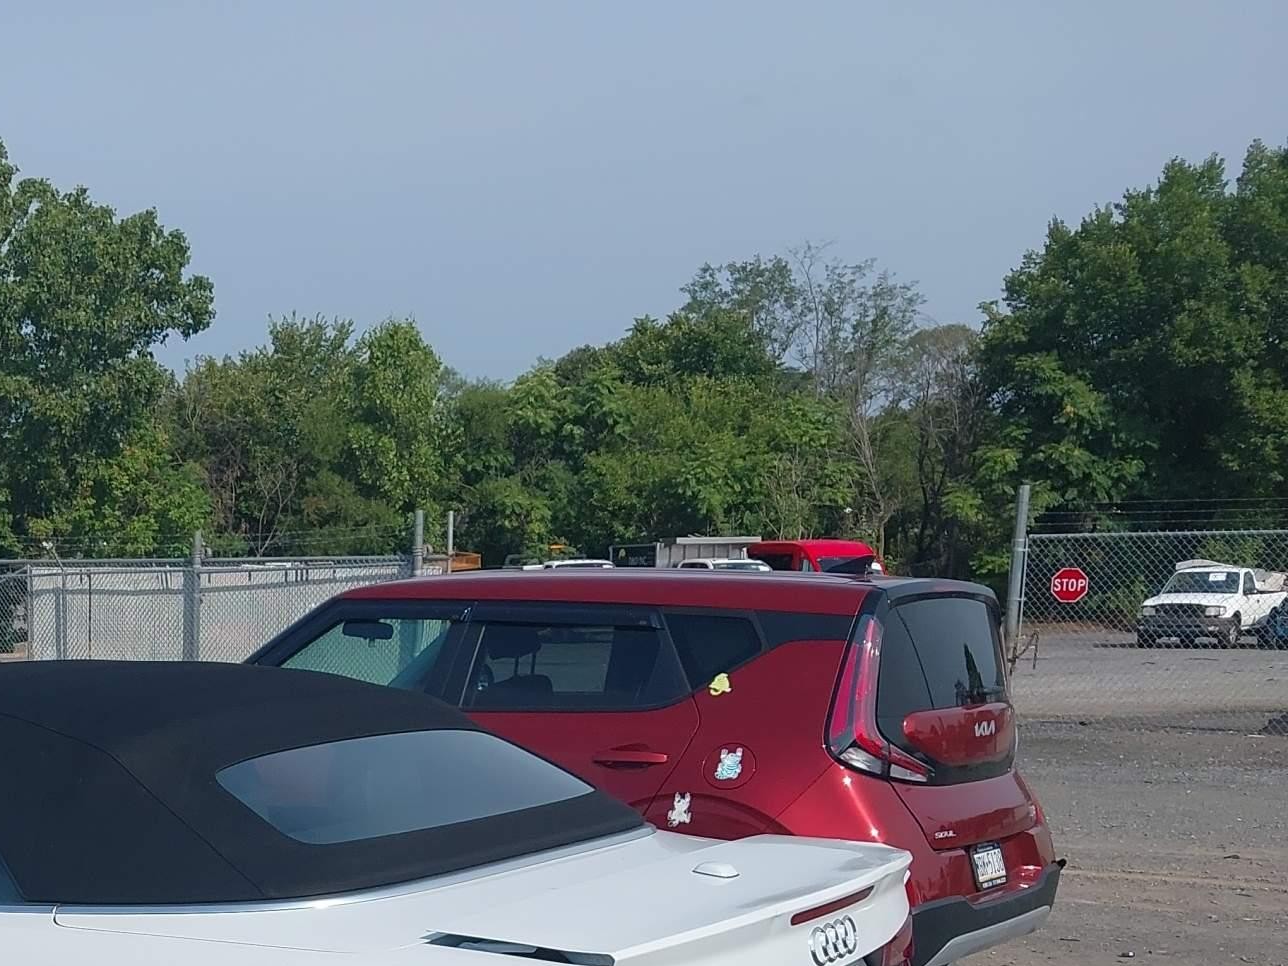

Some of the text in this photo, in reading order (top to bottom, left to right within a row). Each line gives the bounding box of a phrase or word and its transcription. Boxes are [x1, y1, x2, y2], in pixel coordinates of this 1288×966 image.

[1053, 578, 1087, 592] STOP
[974, 719, 996, 737] KIA
[934, 830, 957, 840] SOUL
